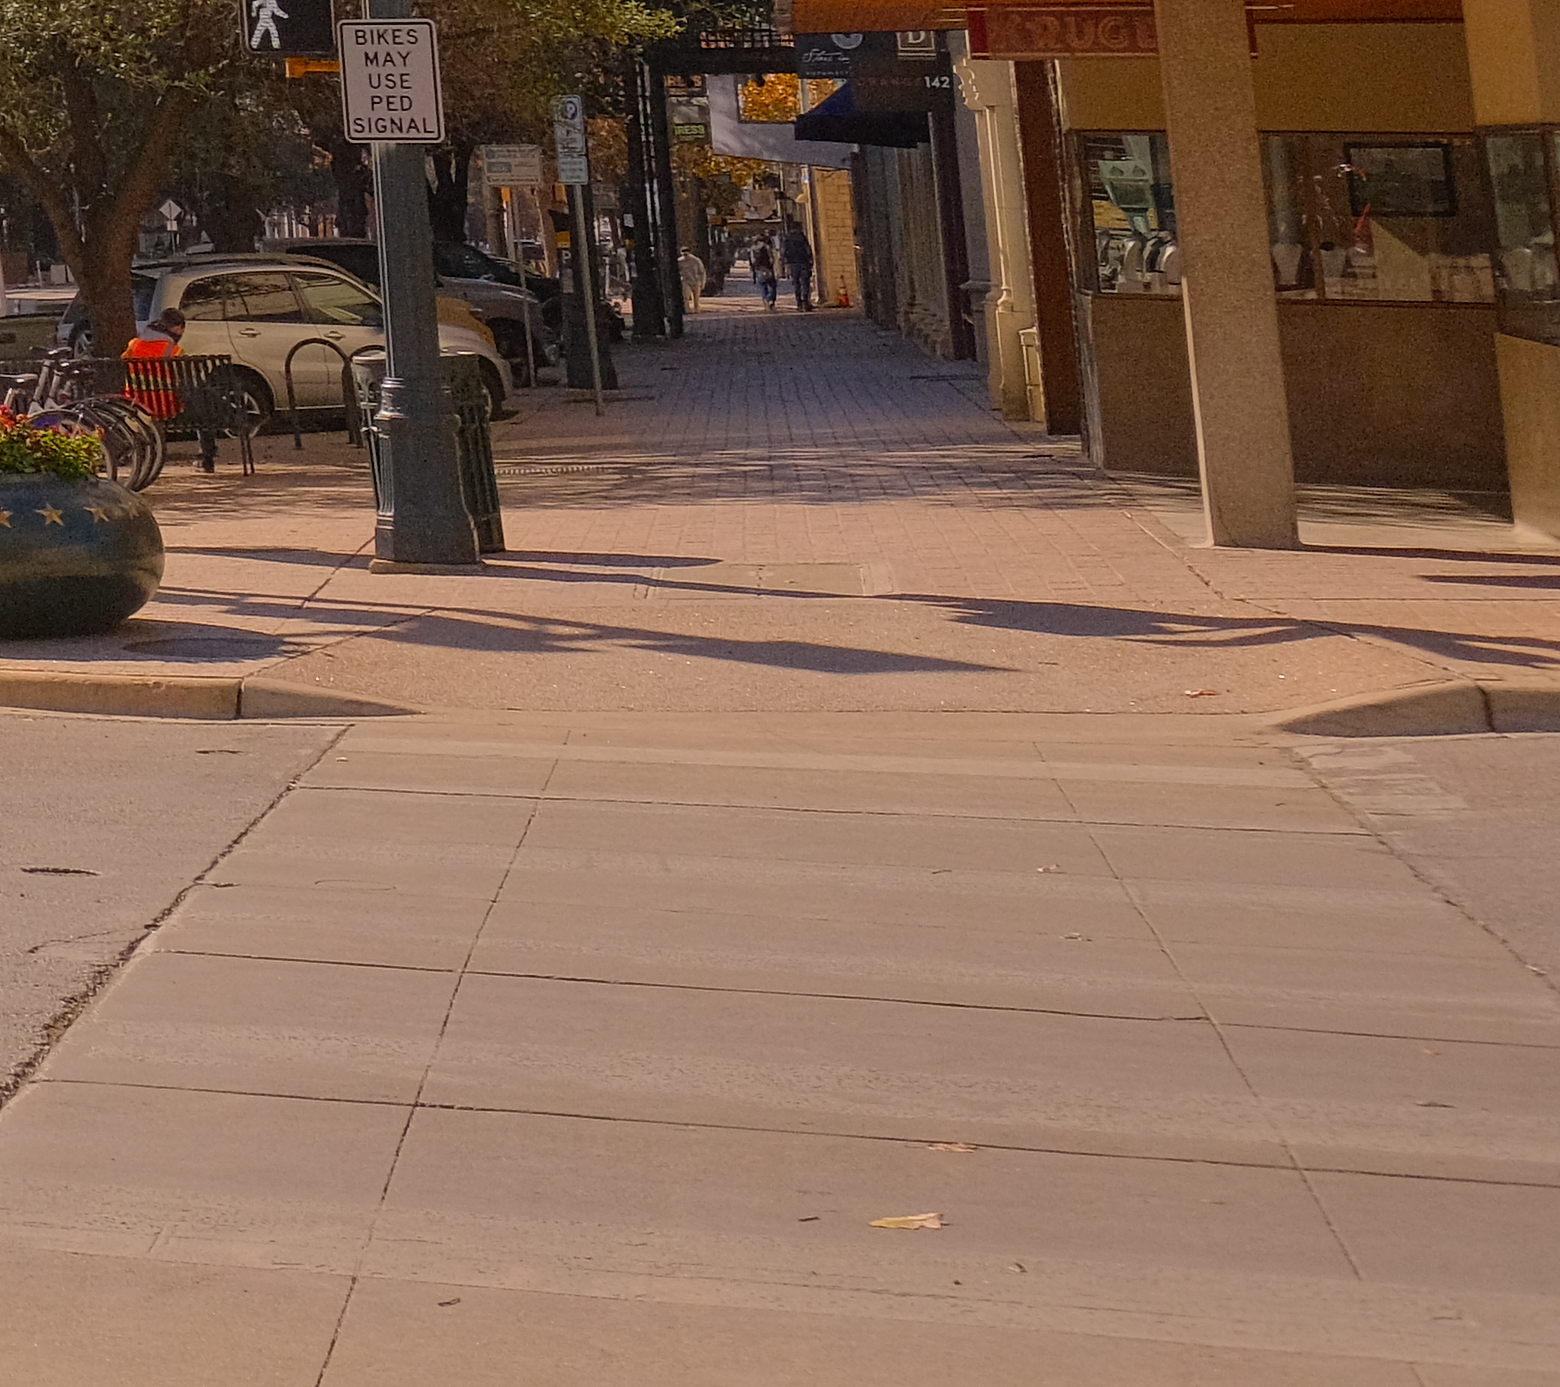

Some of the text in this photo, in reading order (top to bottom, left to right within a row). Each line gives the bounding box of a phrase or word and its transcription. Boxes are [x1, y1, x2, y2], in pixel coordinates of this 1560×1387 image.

[355, 28, 418, 45] BIKES
[364, 51, 411, 67] MAY
[368, 73, 412, 89] USE
[924, 76, 950, 88] 142
[371, 95, 412, 111] PED
[353, 117, 435, 134] SIGNAL
